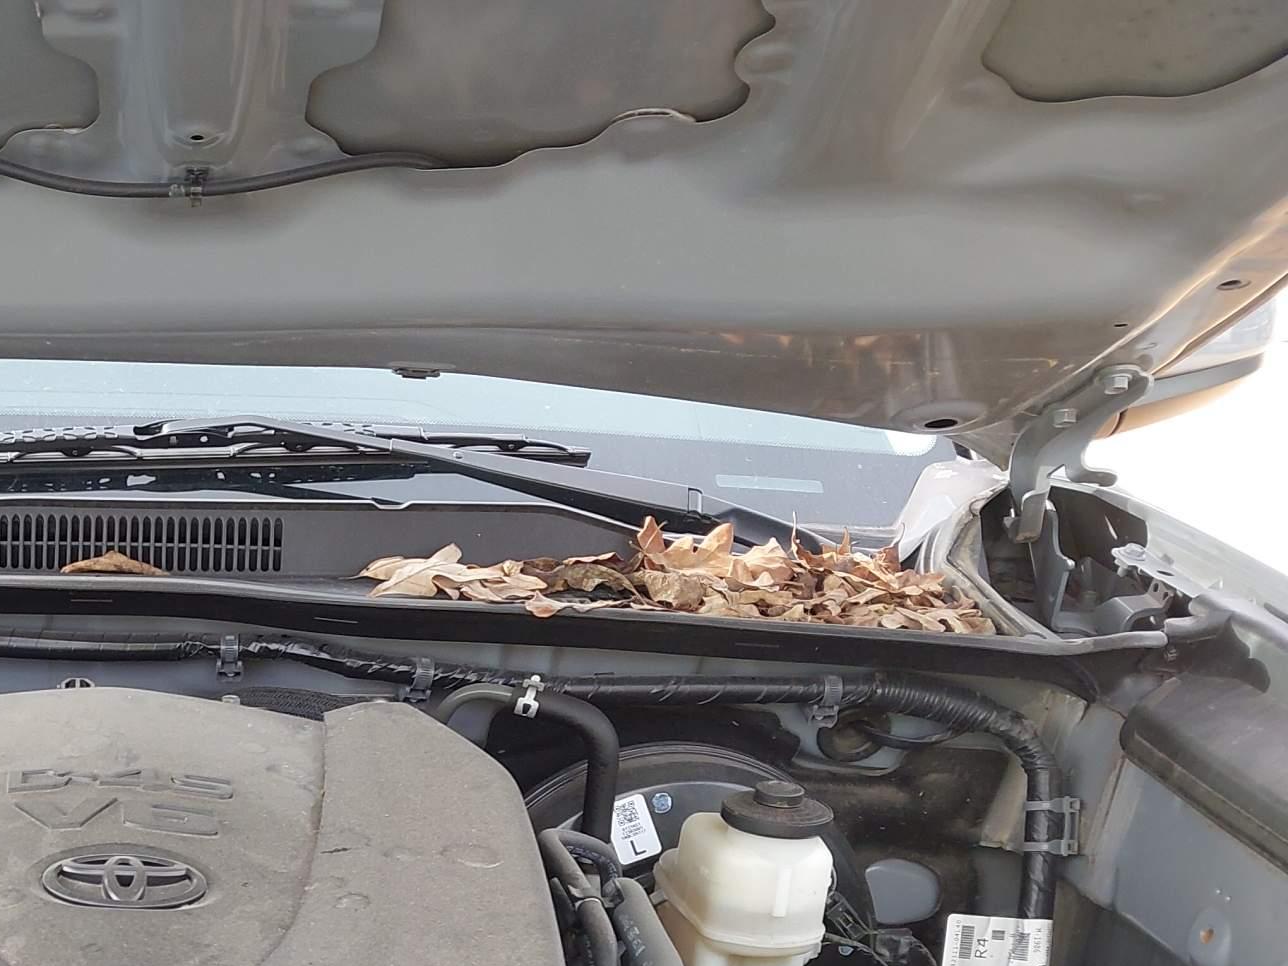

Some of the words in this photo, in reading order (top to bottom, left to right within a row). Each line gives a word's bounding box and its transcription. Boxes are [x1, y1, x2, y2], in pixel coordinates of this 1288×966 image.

[14, 797, 219, 837] V6
[630, 840, 647, 856] L
[974, 938, 989, 959] R4
